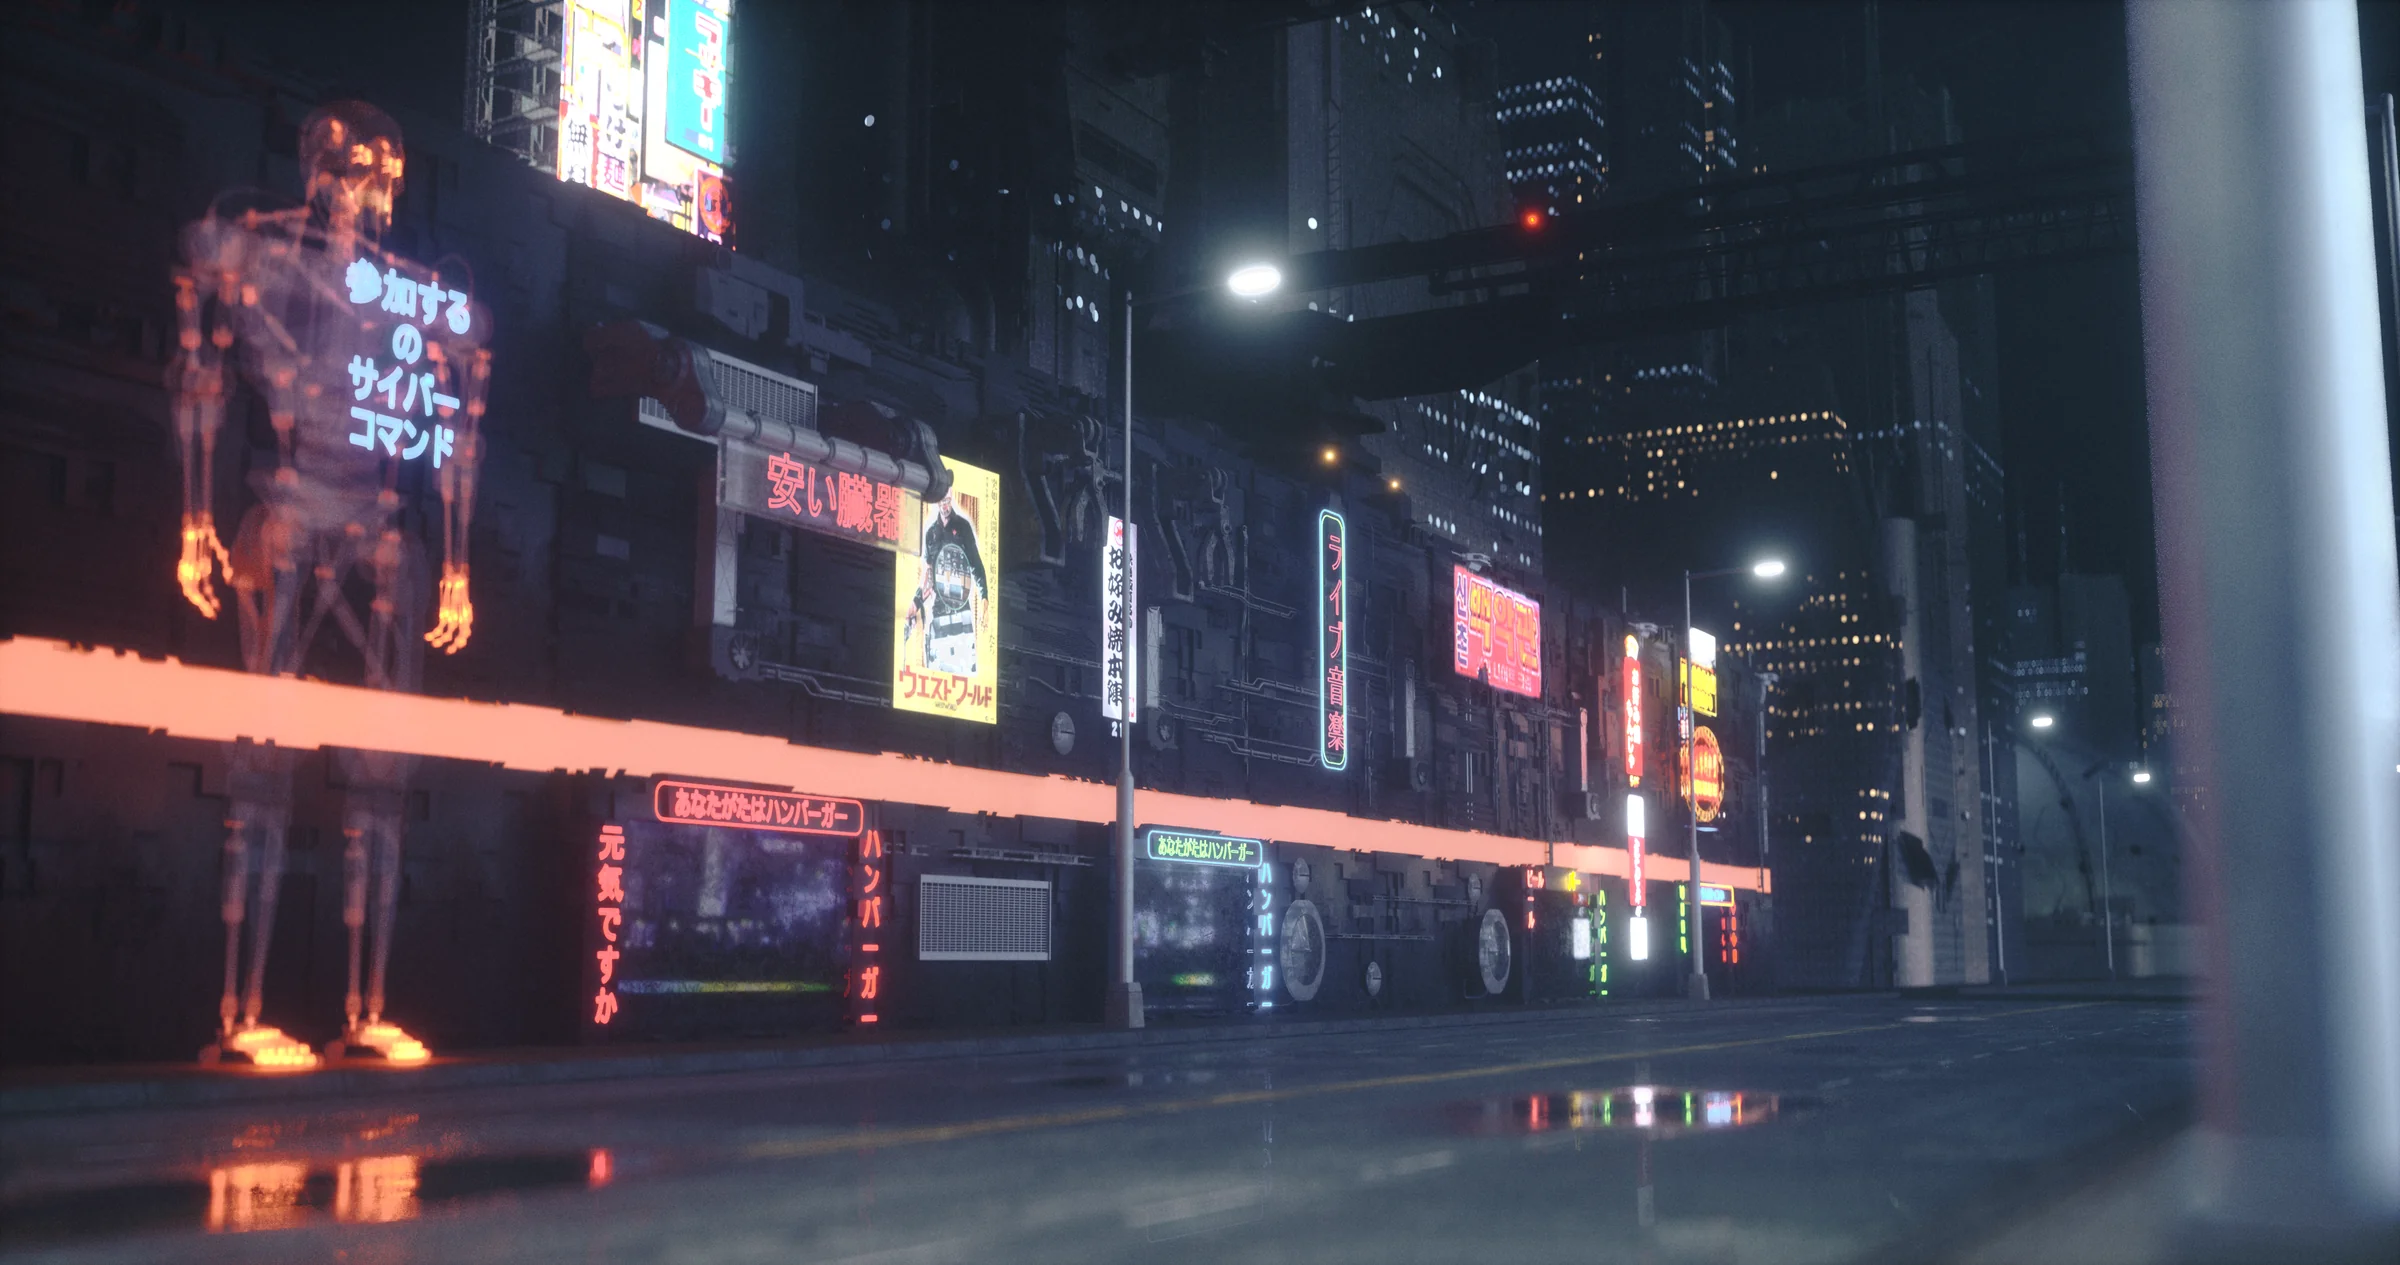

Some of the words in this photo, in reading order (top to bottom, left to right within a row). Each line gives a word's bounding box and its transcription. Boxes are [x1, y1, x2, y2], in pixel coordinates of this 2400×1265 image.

[345, 257, 470, 334] 参加する
[348, 354, 461, 417] サイバー
[392, 323, 423, 365] の
[349, 406, 454, 468] コマンド
[767, 452, 907, 541] 安い臓器
[1456, 572, 1468, 669] 신촌
[1469, 578, 1540, 676] 백악관
[899, 665, 992, 708] ウエストワールド
[674, 788, 849, 829] あなたがたはハンバーガー
[1157, 835, 1254, 862] あなたがたはハンバーガー
[594, 825, 625, 1024] 元気ですか
[861, 829, 882, 1023] ハンバーガー
[1261, 862, 1273, 1008] ハンバーガー
[1600, 889, 1608, 996] ハンバーガー
